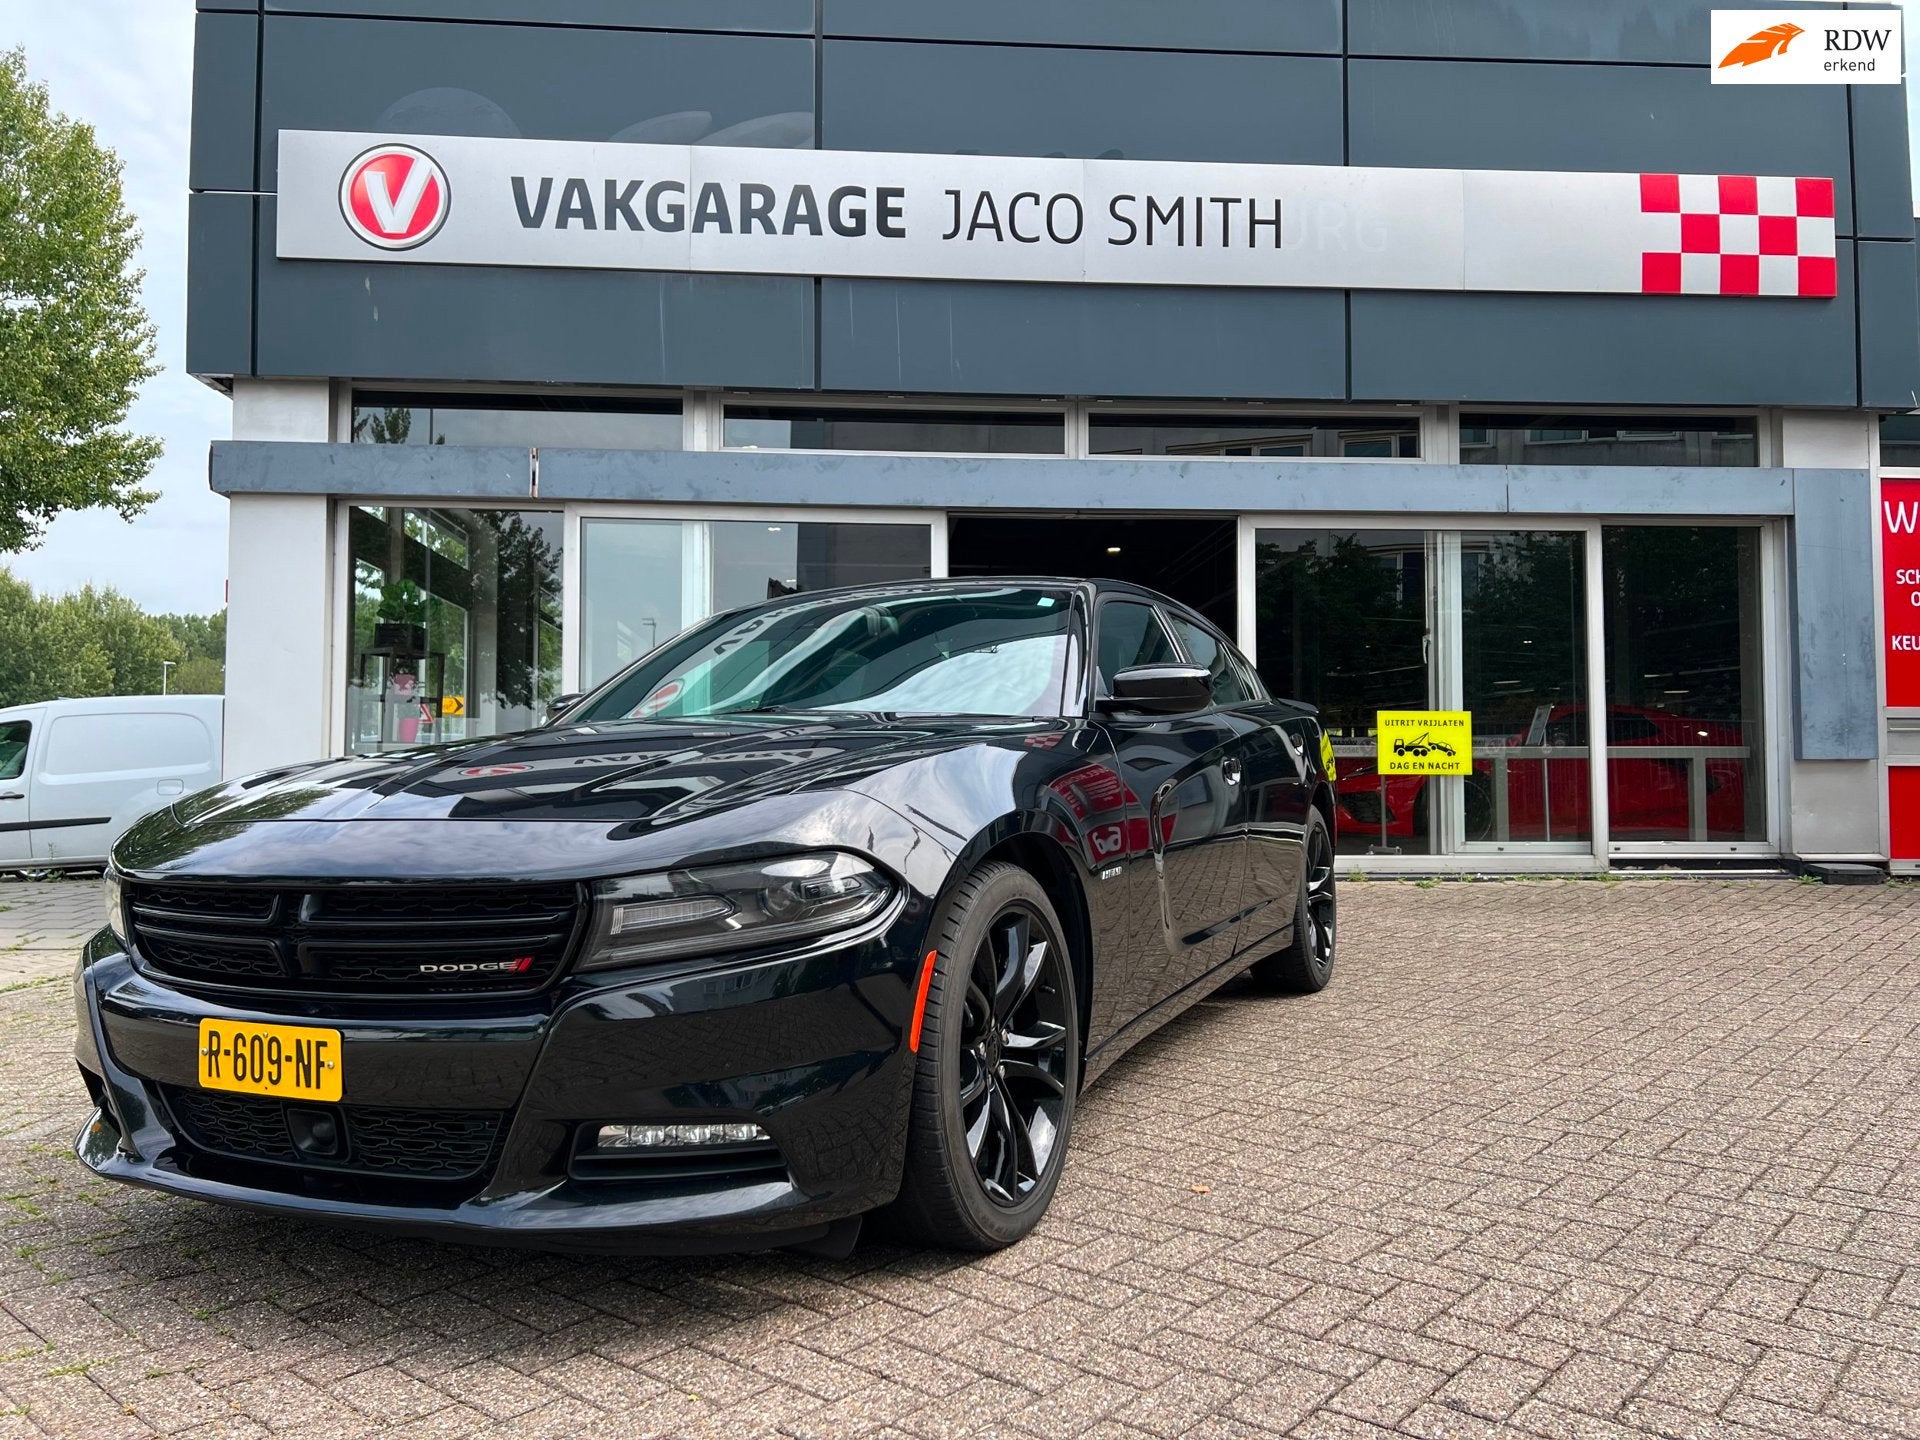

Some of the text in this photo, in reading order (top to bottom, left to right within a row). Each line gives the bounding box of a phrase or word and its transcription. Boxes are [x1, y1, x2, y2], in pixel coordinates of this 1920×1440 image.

[510, 176, 1282, 249] VAKGARAGE JACO SMITH
[1384, 719, 1465, 727] UITRIT VRIJLATEN
[1389, 762, 1460, 770] DAG EN NACHT
[420, 961, 518, 973] DODGE
[208, 1030, 328, 1090] R-609-NF
